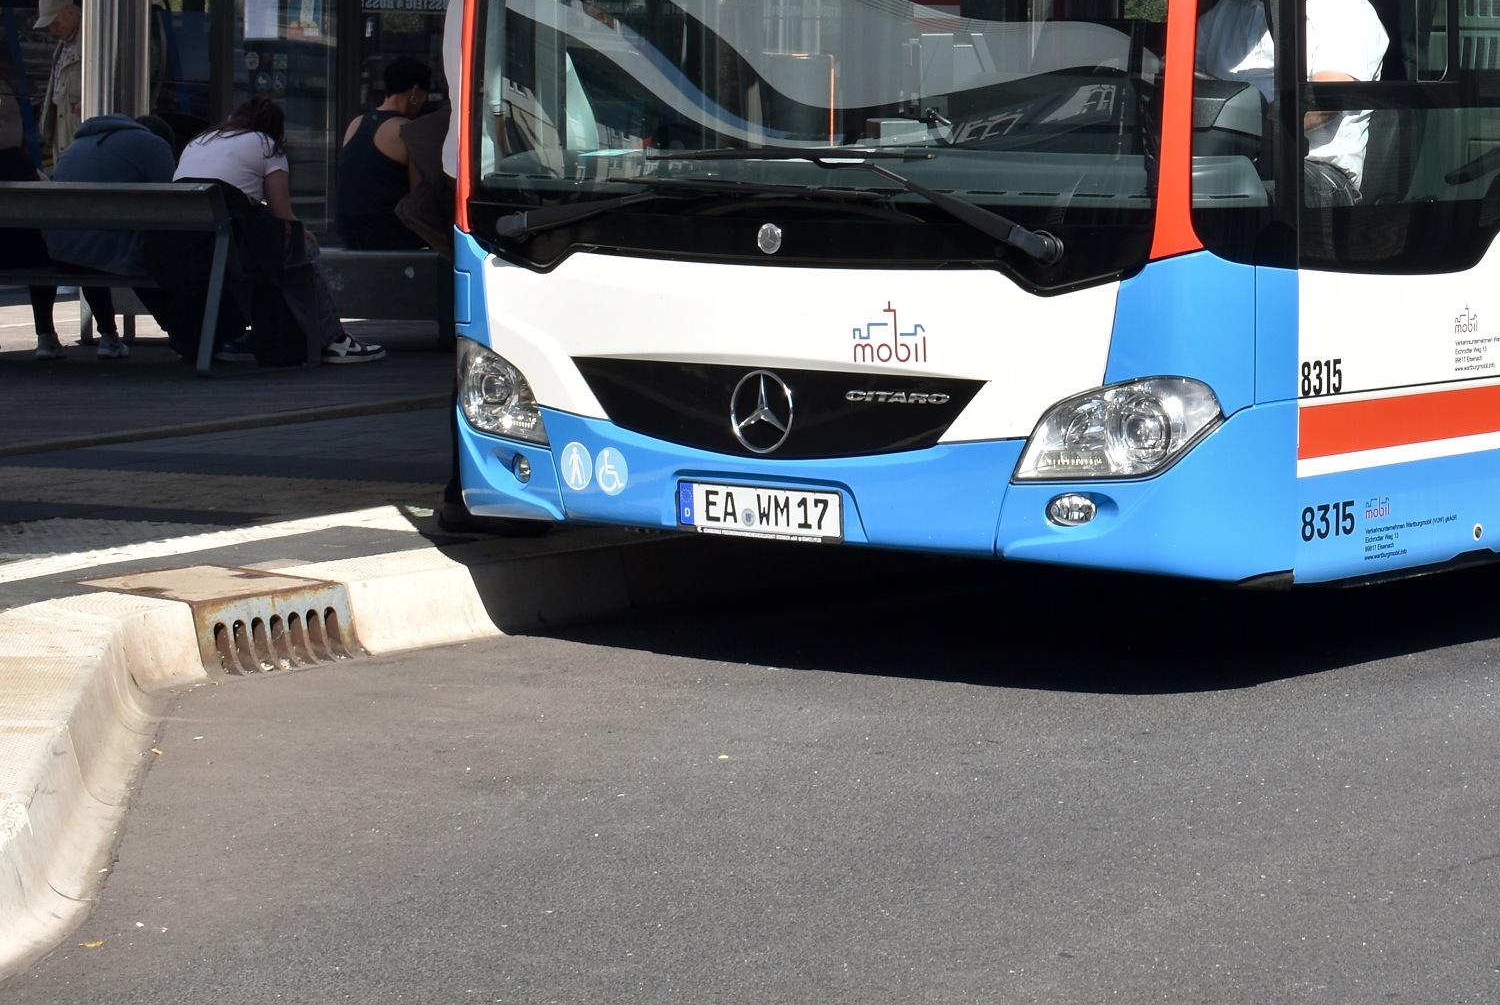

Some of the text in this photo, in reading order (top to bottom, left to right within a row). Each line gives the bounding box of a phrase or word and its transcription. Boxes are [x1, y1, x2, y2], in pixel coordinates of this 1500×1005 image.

[853, 311, 927, 363] mobil
[1454, 310, 1478, 334] mobil
[1301, 358, 1342, 396] 8315
[845, 389, 951, 405] CITARO
[685, 507, 691, 518] D
[705, 489, 829, 531] EA WM 17
[1301, 500, 1355, 543] 8315
[1365, 496, 1390, 520] mobil
